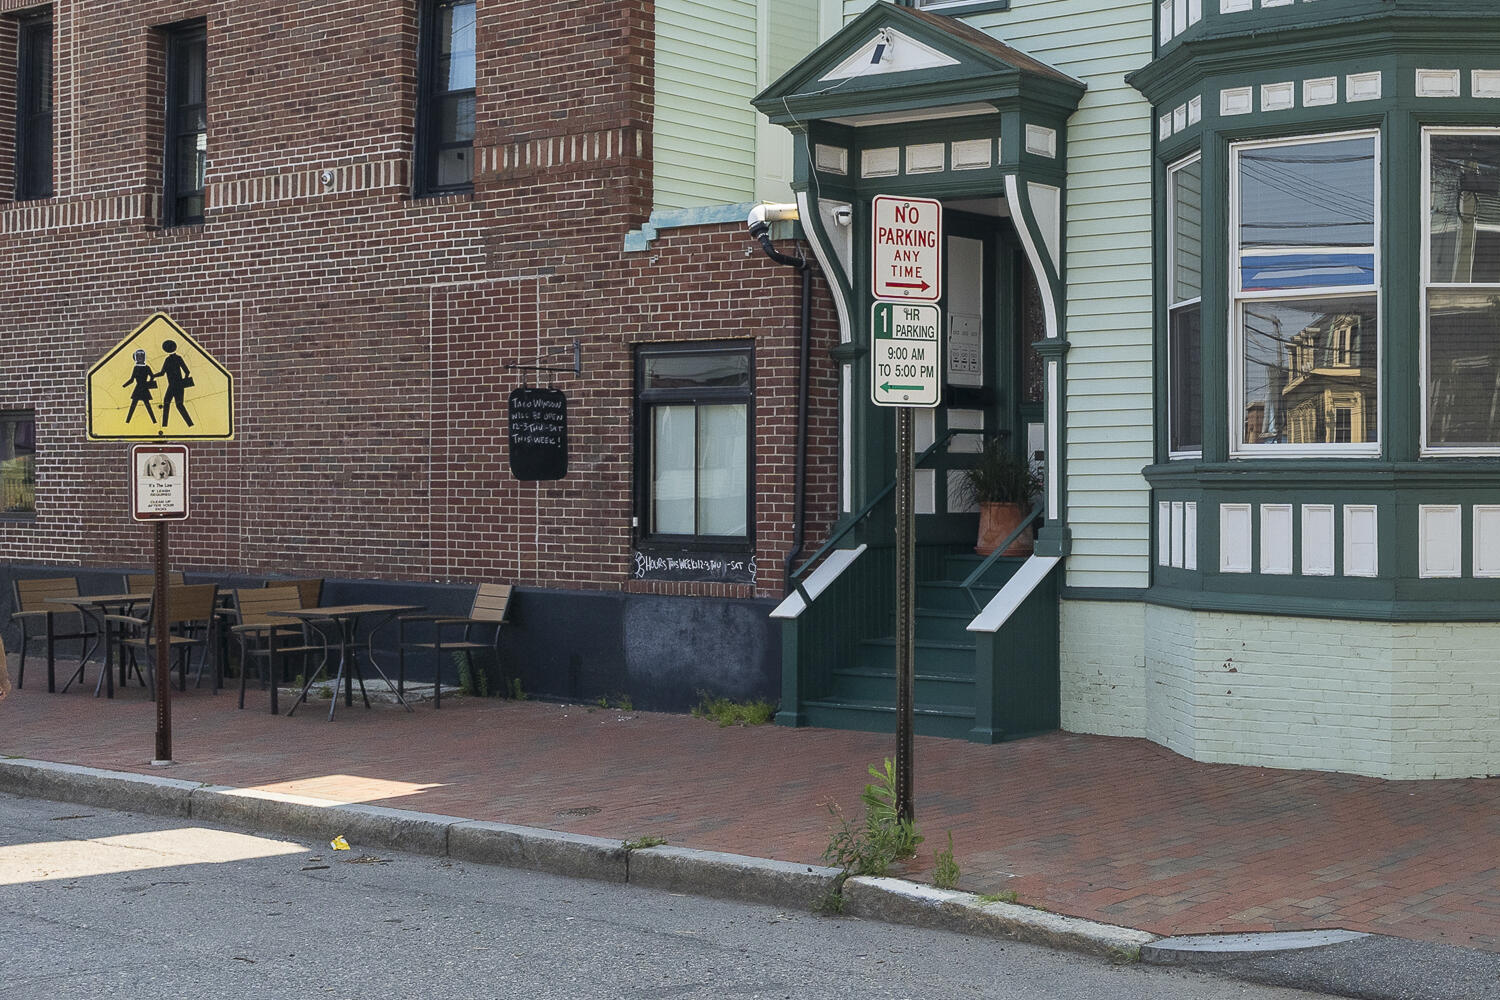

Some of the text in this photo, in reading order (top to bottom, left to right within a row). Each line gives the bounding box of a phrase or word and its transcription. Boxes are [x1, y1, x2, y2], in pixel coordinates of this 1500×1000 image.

[895, 206, 920, 224] NO
[878, 227, 936, 248] PARKING
[894, 250, 920, 262] ANY
[891, 265, 922, 278] TIME
[880, 308, 888, 332] 1
[906, 308, 920, 321] HR
[896, 324, 934, 338] PARKING
[888, 346, 924, 361] 9:00 AM
[878, 364, 934, 378] TO 5:00 PM
[512, 398, 532, 408] TACO
[512, 433, 531, 444] THIS
[645, 556, 667, 571] HOURS
